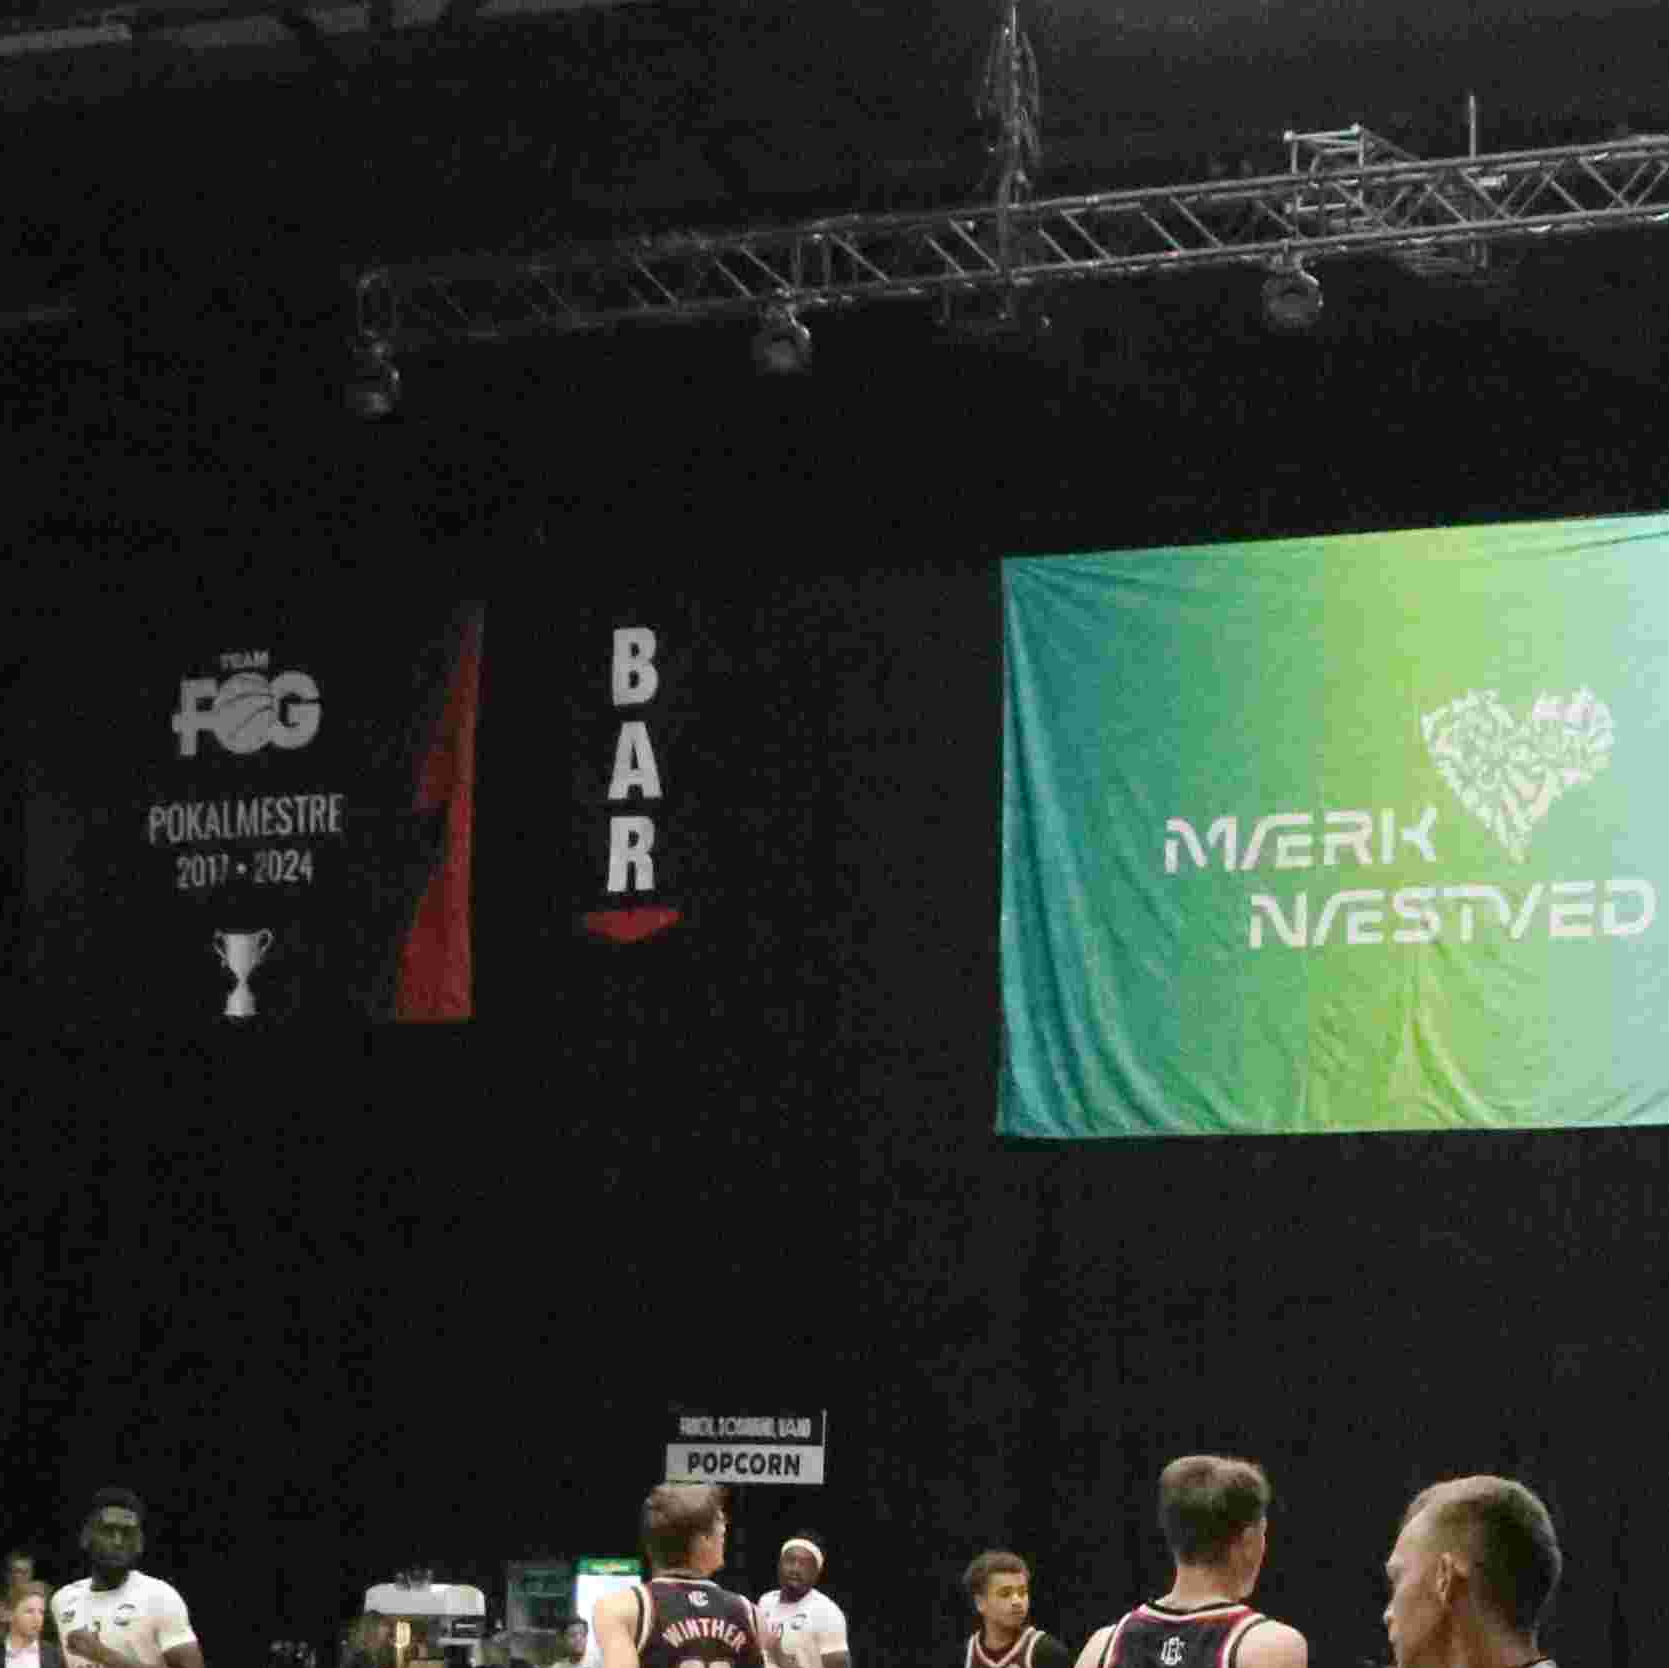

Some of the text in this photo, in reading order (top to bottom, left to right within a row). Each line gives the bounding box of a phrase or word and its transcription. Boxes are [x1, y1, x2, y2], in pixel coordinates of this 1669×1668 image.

[173, 671, 322, 756] FOG
[148, 794, 344, 843] POKALMESTRE
[176, 849, 313, 888] 2017 2024
[687, 1452, 801, 1477] POPCORN
